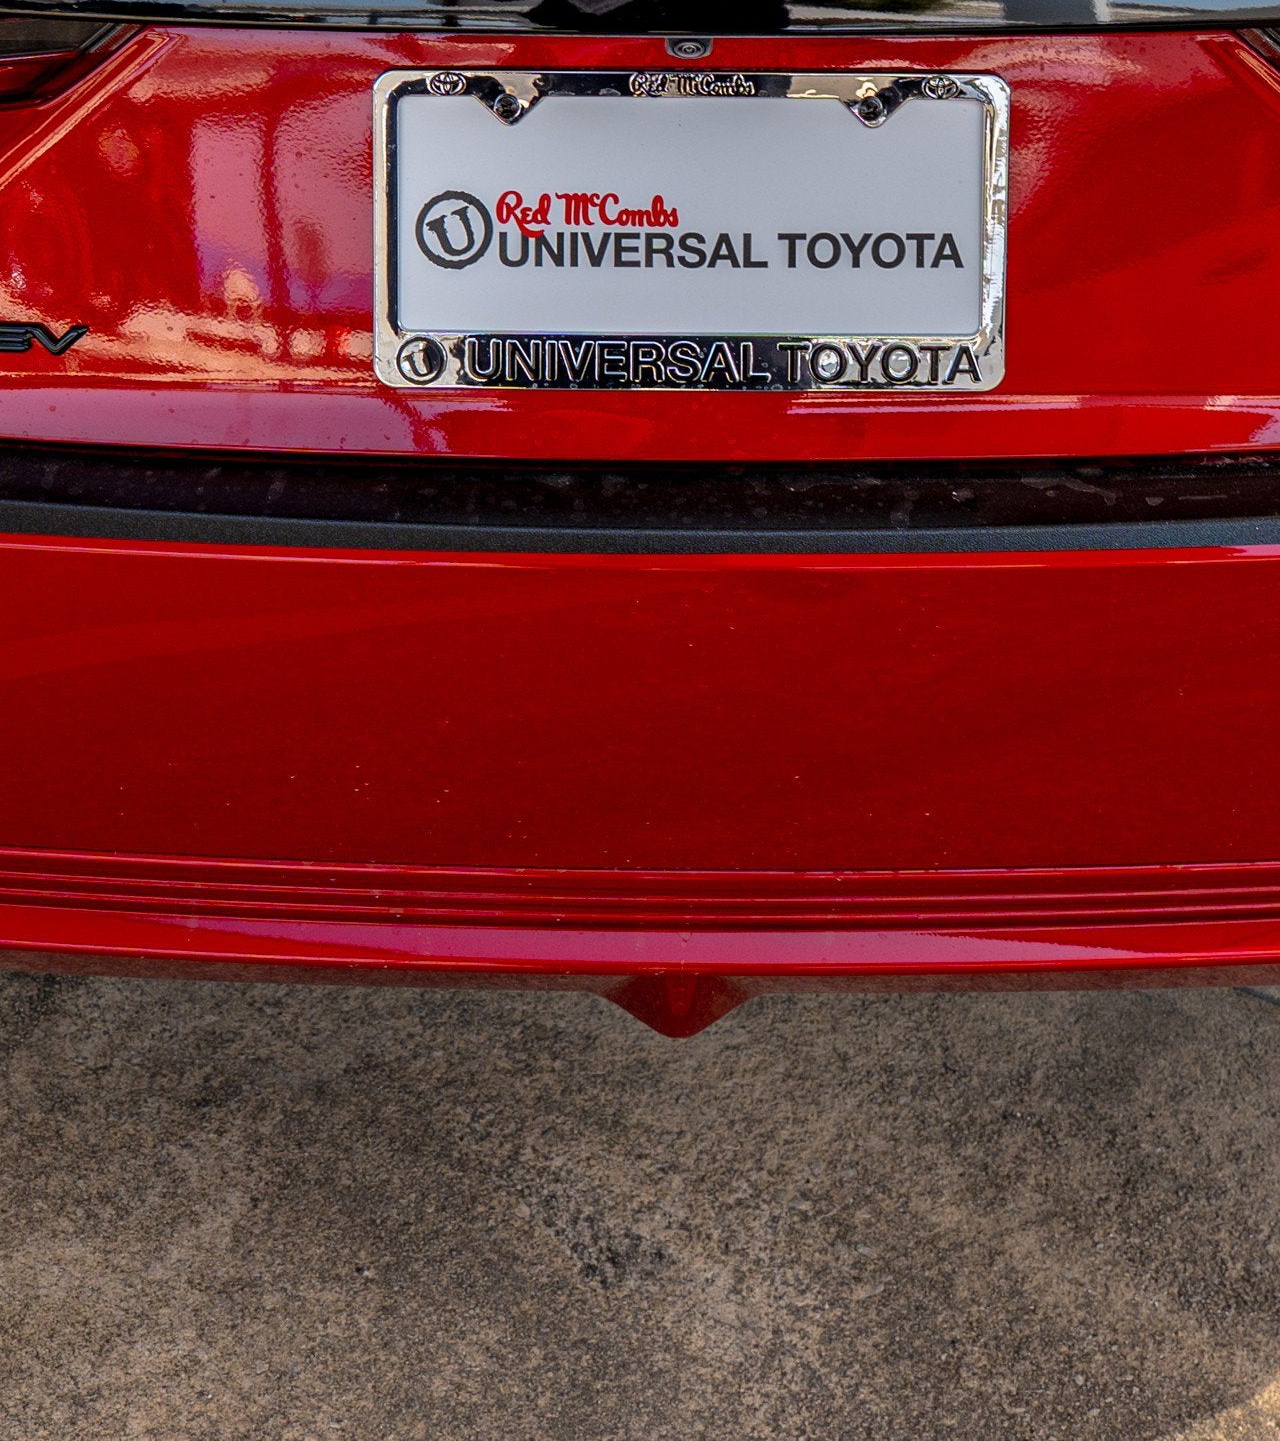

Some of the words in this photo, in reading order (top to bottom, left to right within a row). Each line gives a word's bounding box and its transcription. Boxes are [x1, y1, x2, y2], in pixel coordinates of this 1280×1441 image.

[669, 72, 756, 97] McCombs
[496, 190, 551, 238] Red
[555, 192, 679, 228] McCombs
[499, 231, 769, 269] UNIVERSAL
[777, 232, 965, 269] TOYOTA
[465, 338, 771, 384] UNIVERSAL
[777, 341, 983, 385] TOYOTA
